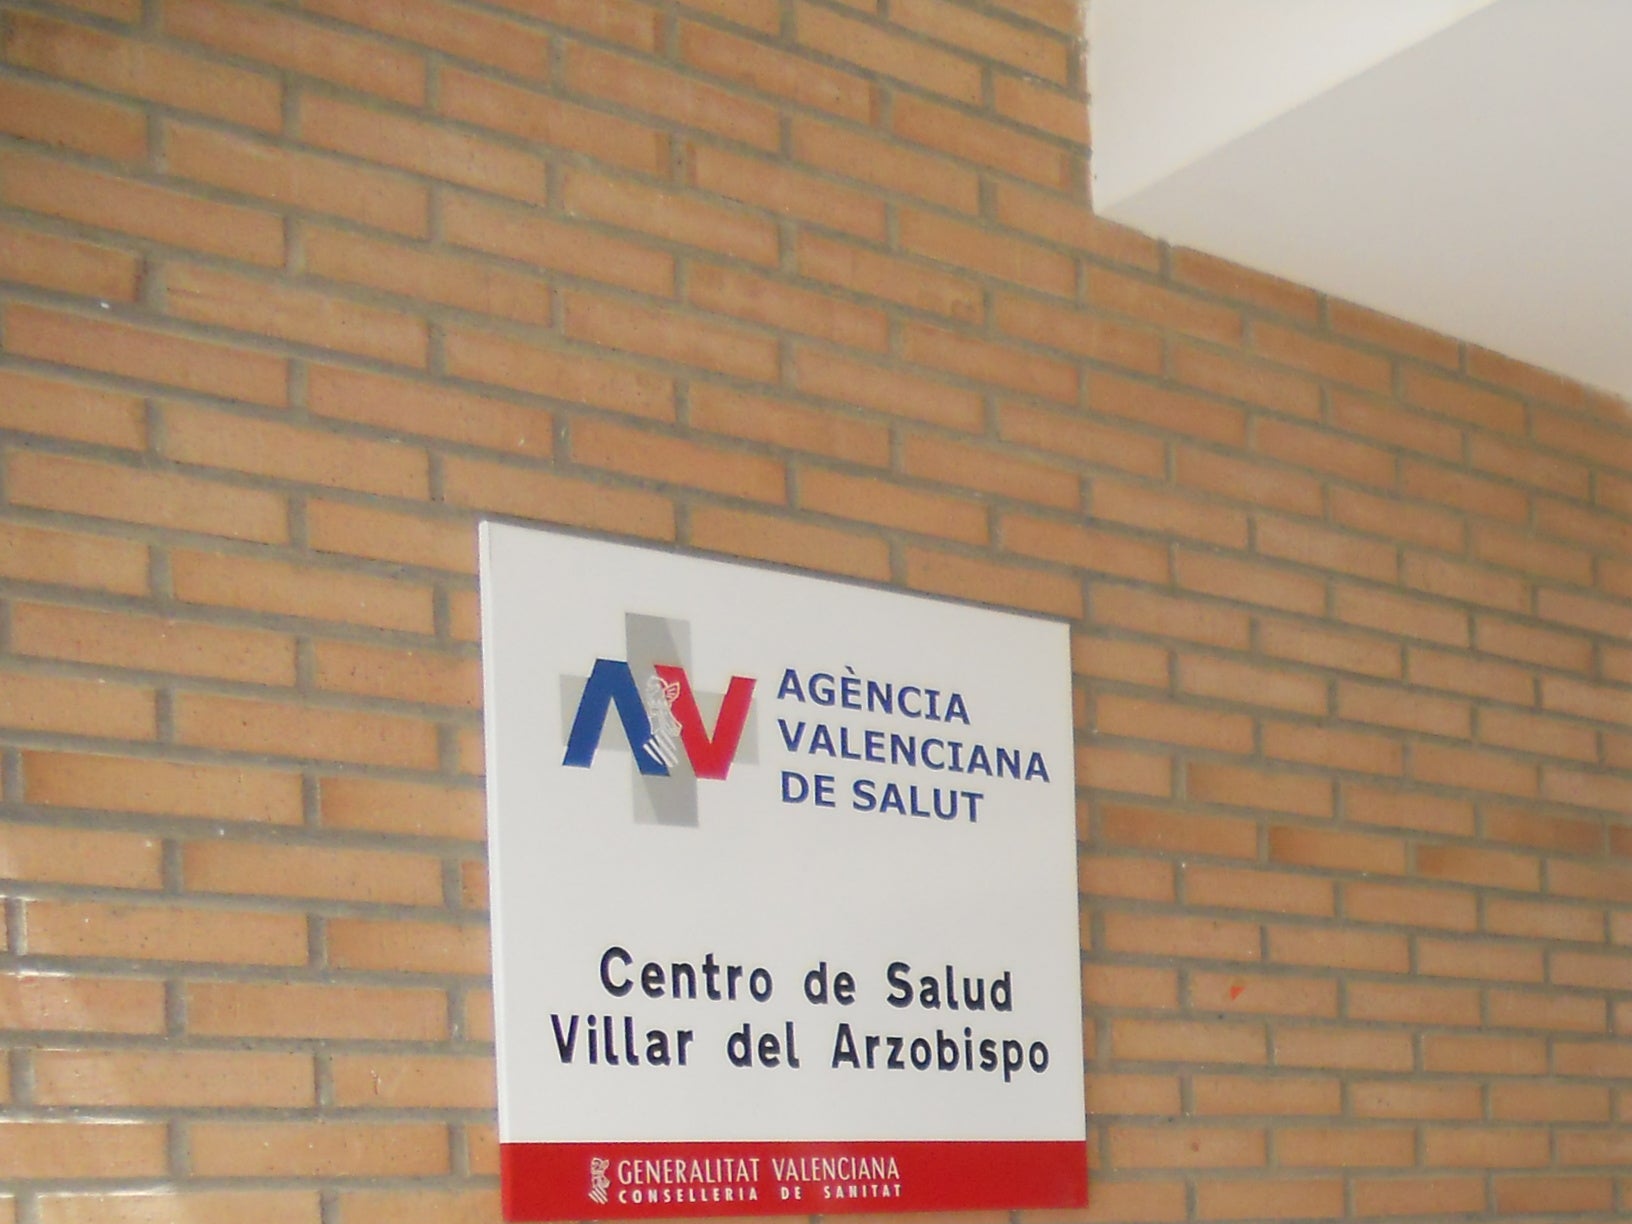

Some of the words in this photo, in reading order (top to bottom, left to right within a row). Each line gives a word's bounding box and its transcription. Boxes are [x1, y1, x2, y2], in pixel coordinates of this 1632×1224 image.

[777, 666, 971, 726] AGÈNCIA
[777, 719, 1051, 783] VALENCIANA
[781, 771, 836, 808] DE
[852, 779, 985, 823] SALUT
[599, 947, 774, 1003] Centro
[803, 961, 857, 1006] de
[886, 961, 1013, 1013] Salud
[550, 1014, 694, 1067] Villar
[727, 1021, 800, 1069] del
[831, 1023, 1051, 1083] Arzobispo
[617, 1157, 760, 1186] GENERALITAT
[771, 1156, 900, 1182] VALENCIANA
[618, 1186, 758, 1204] CONSELLERIA
[780, 1186, 802, 1200] DE
[823, 1183, 901, 1199] SANITAT
